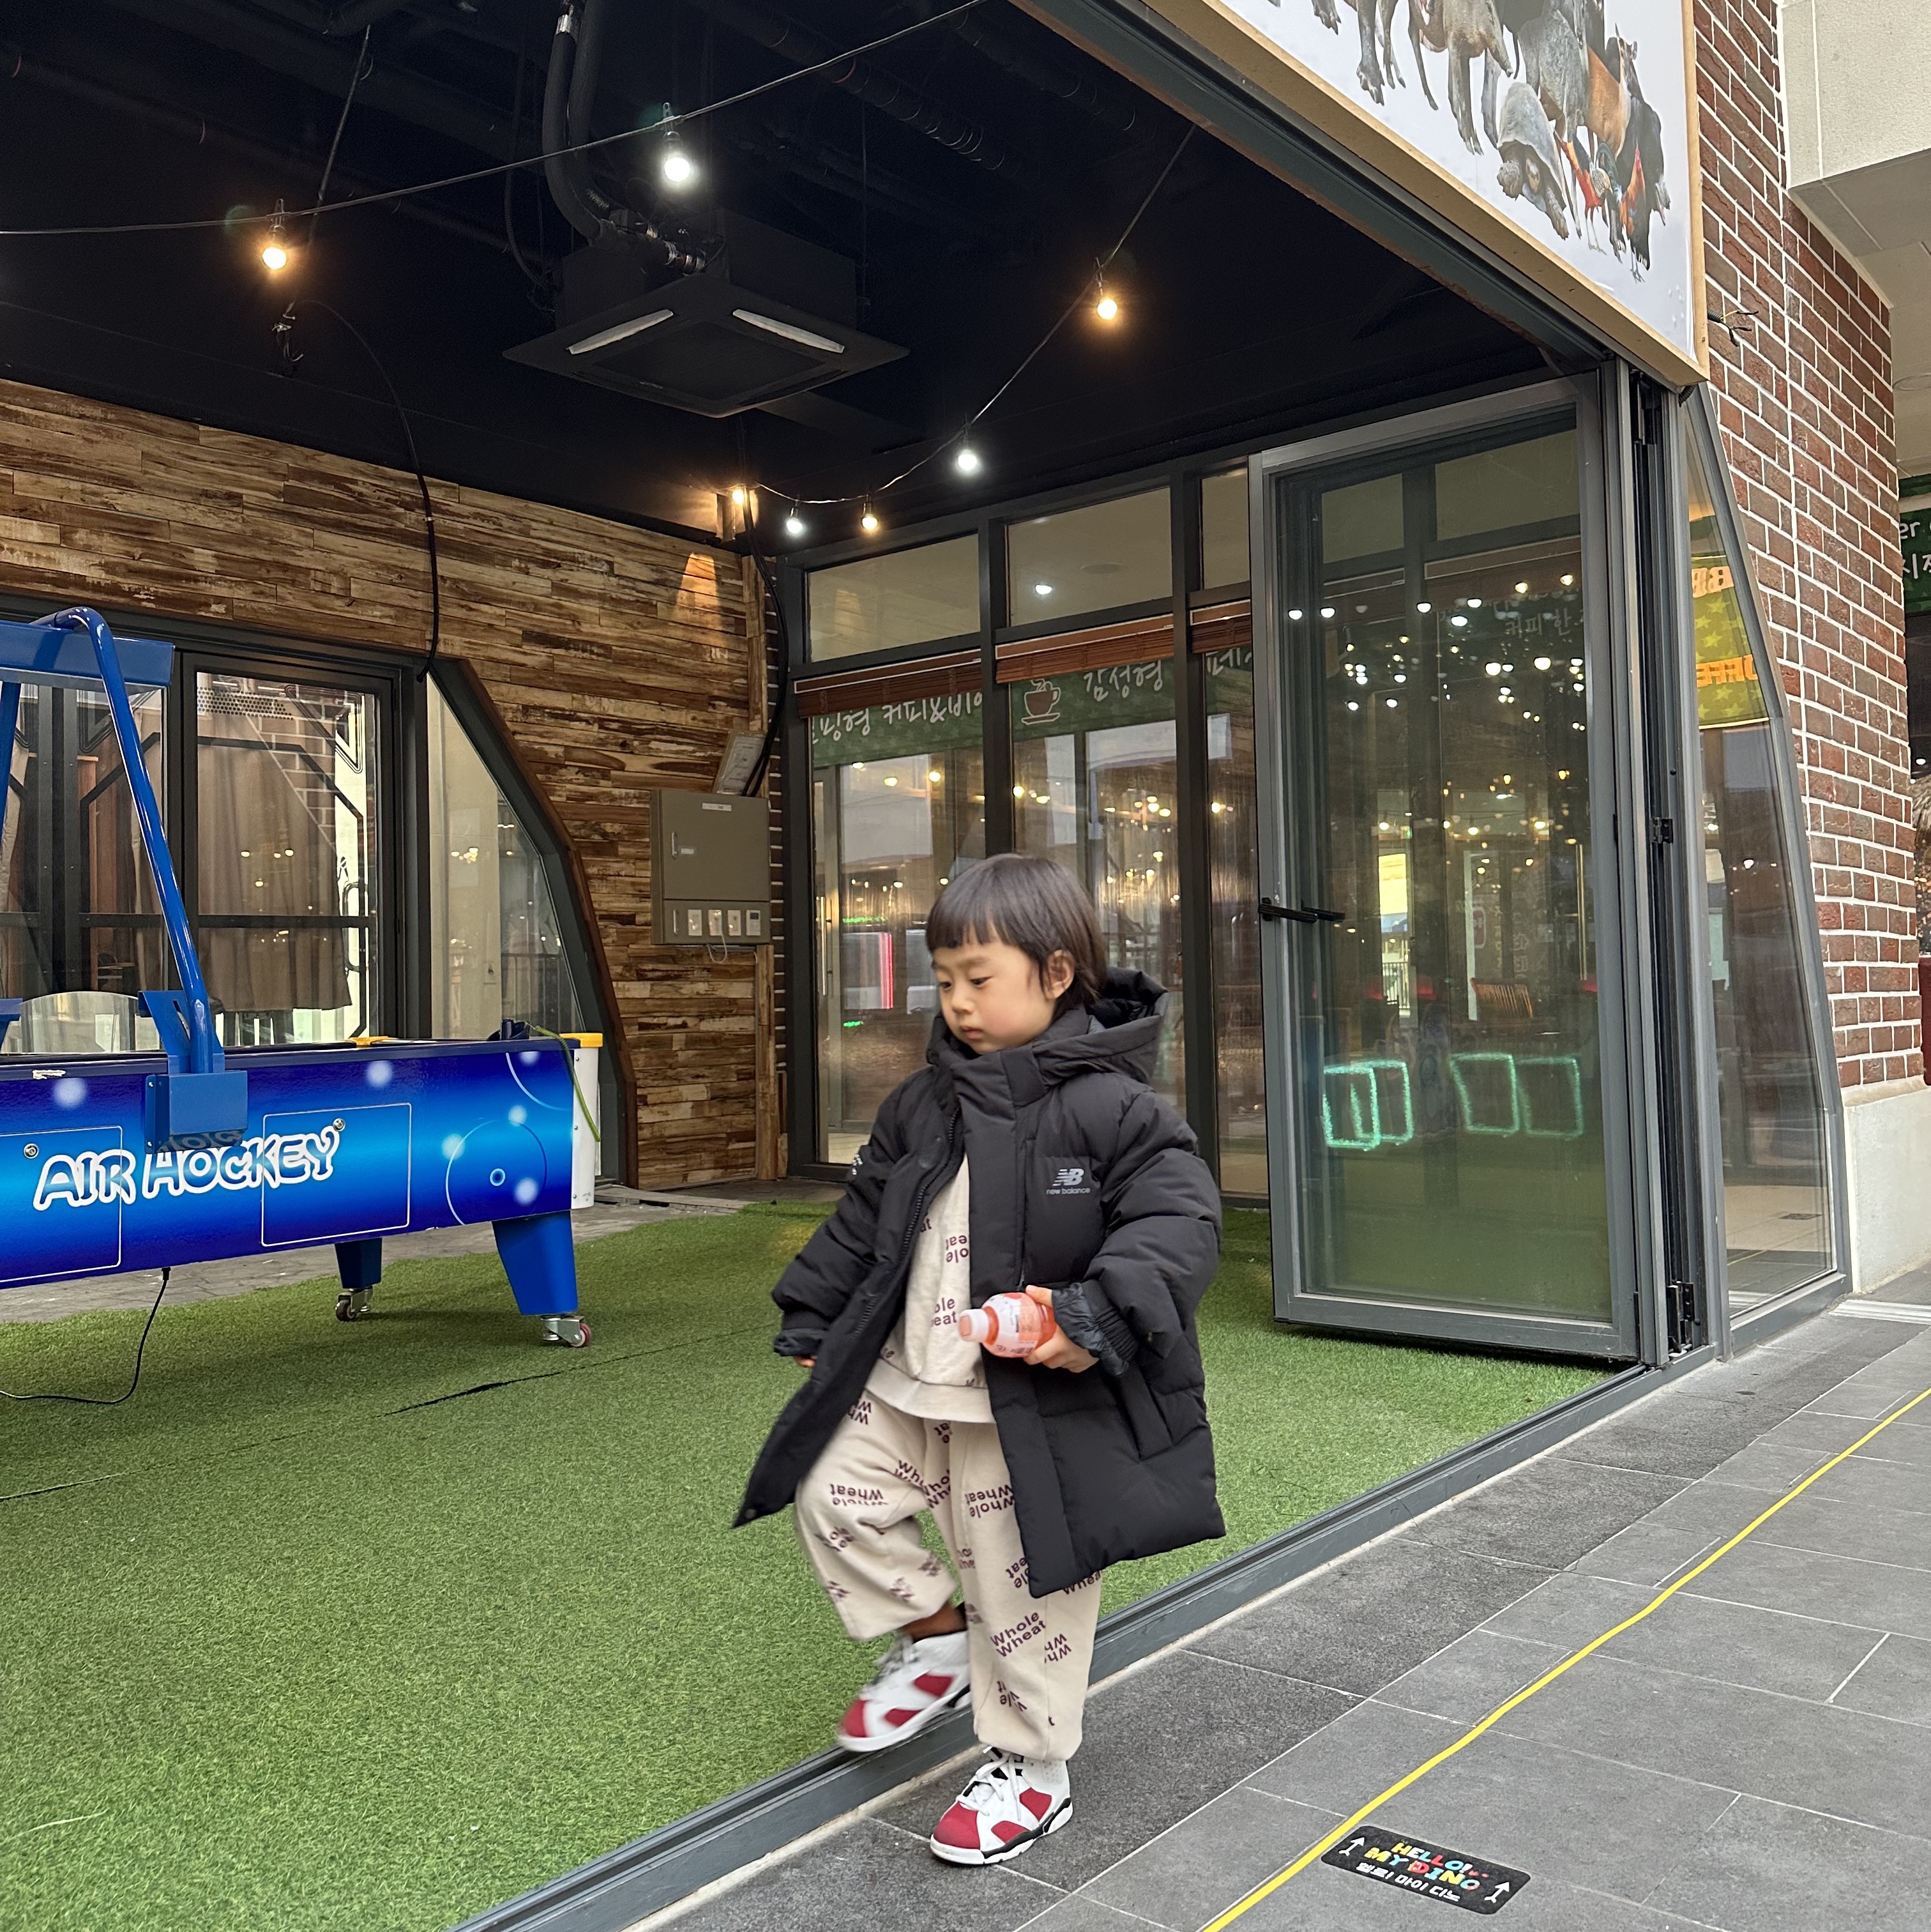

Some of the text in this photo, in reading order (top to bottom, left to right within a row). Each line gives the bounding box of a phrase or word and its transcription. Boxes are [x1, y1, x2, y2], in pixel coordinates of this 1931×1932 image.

[33, 1127, 340, 1211] AIR HOCKEY
[829, 1483, 884, 1500] Wheat
[990, 1612, 1040, 1647] Whole
[996, 1620, 1047, 1657] Wheat
[1364, 1847, 1480, 1890] MY DINO
[1391, 1843, 1473, 1873] HELLO!
[1395, 1875, 1429, 1890] 마이
[1429, 1885, 1461, 1902] 디노
